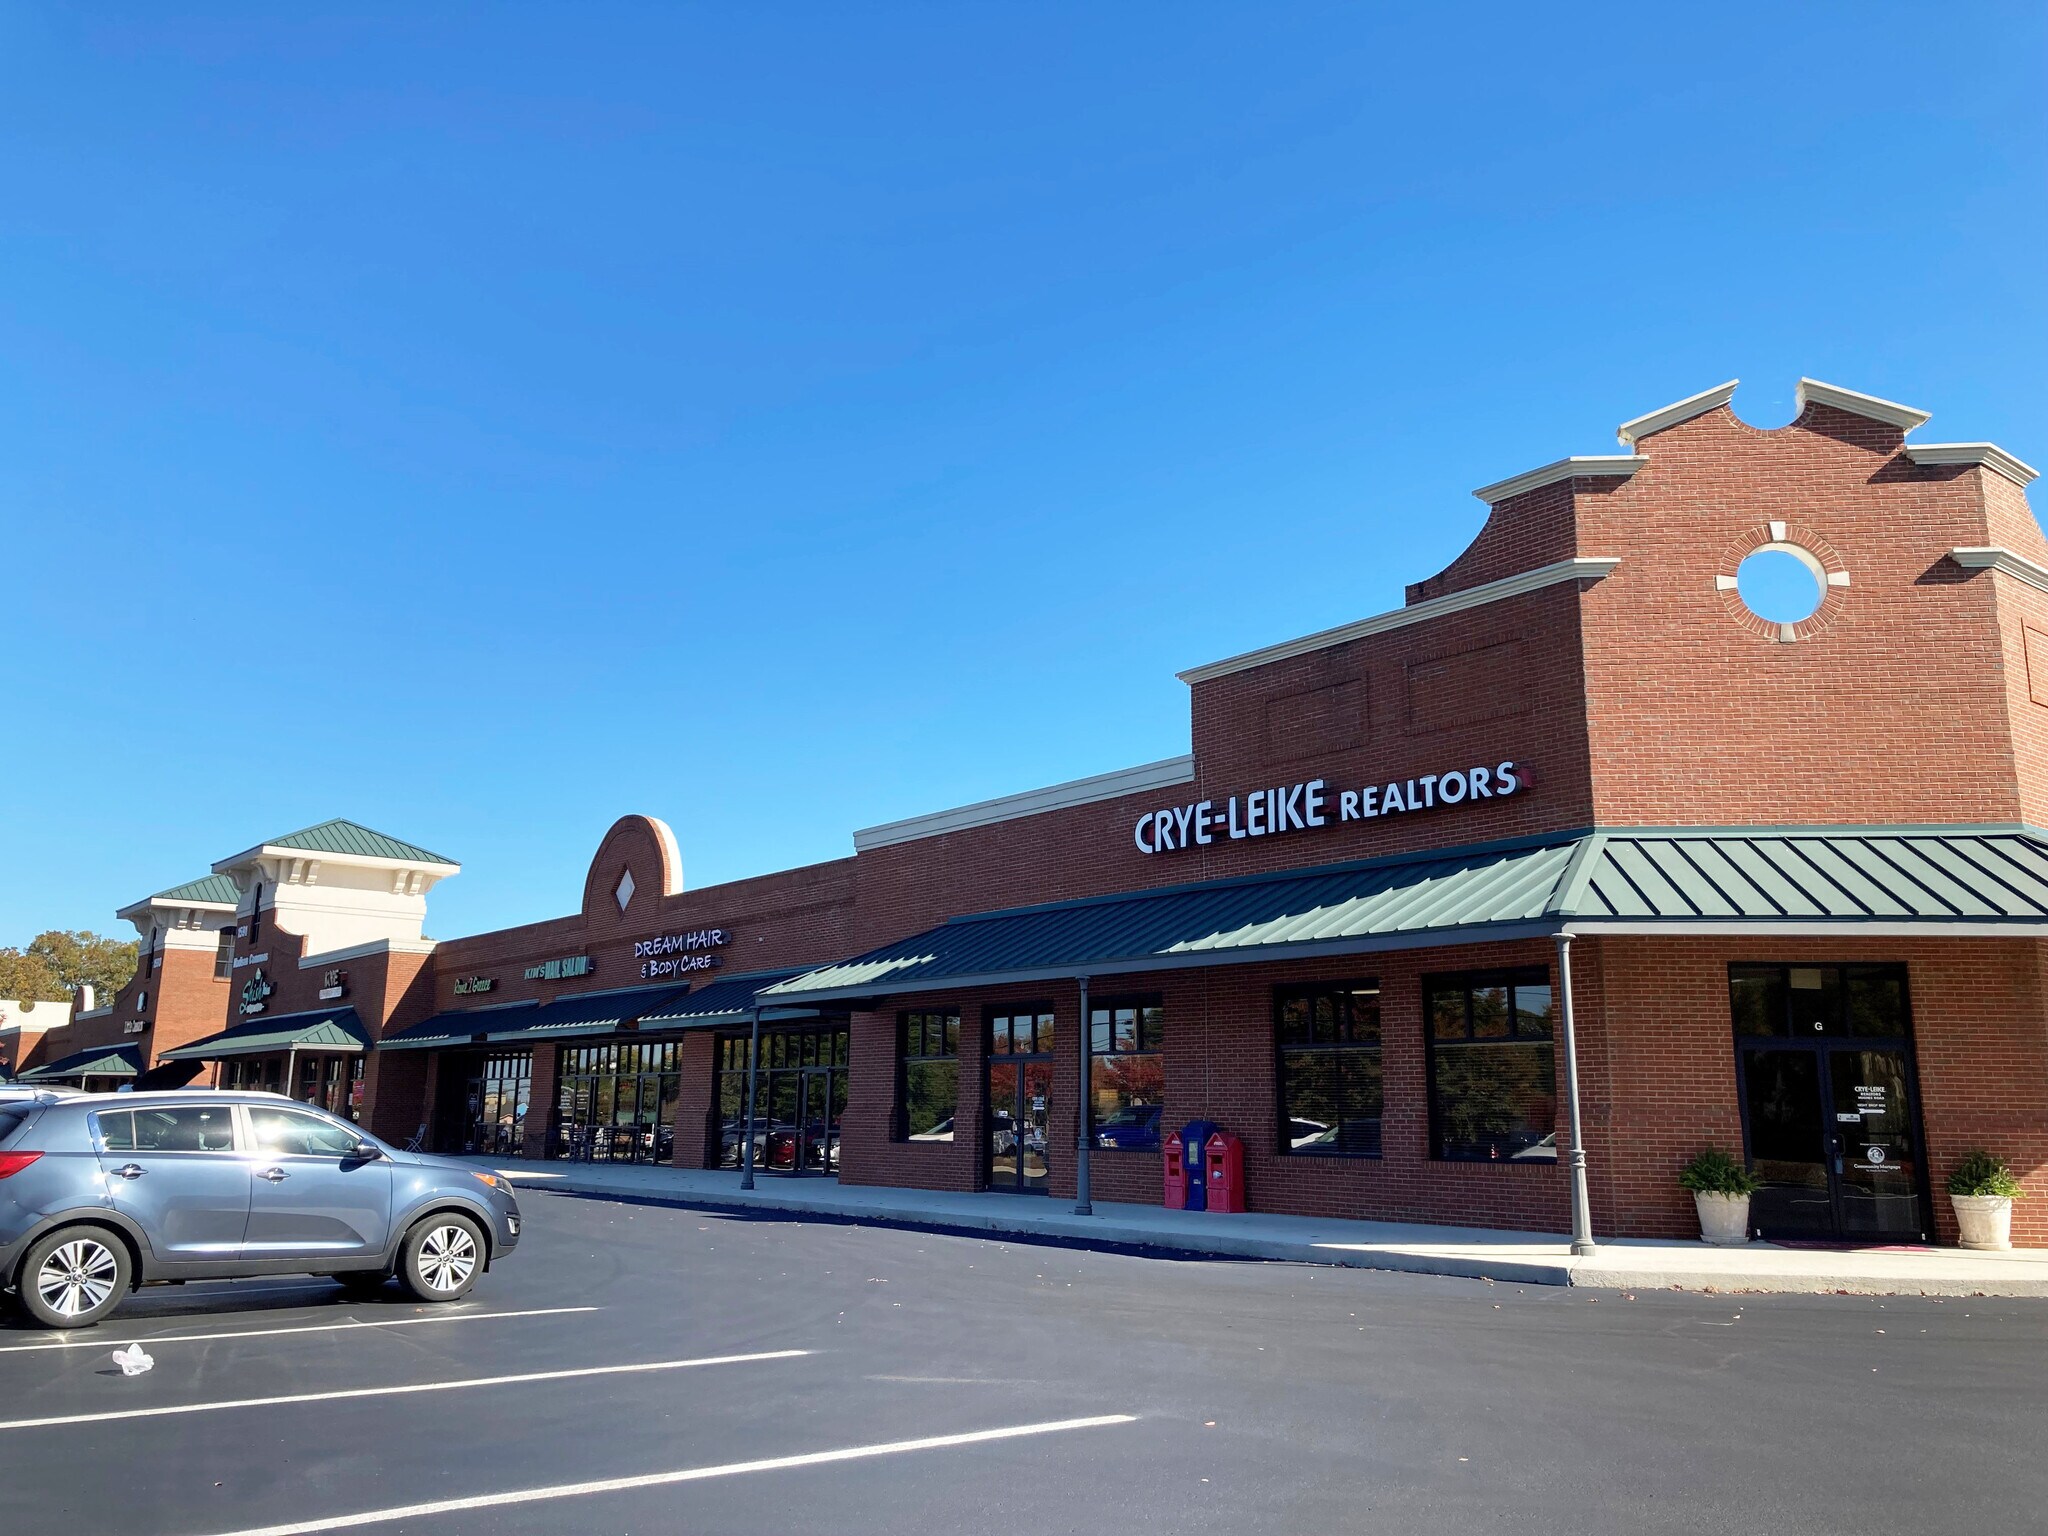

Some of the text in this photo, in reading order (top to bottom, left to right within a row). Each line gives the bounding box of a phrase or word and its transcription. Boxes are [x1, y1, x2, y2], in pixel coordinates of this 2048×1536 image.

[1134, 761, 1518, 854] CRYE-LEIKE REALTORS
[634, 929, 723, 958] DREAM HAIR
[545, 960, 561, 980] NAIL
[562, 955, 588, 978] SALON
[640, 954, 712, 979] & BODY CARE
[1814, 1021, 1824, 1031] G
[1854, 1085, 1887, 1093] CRYE-LEIKE
